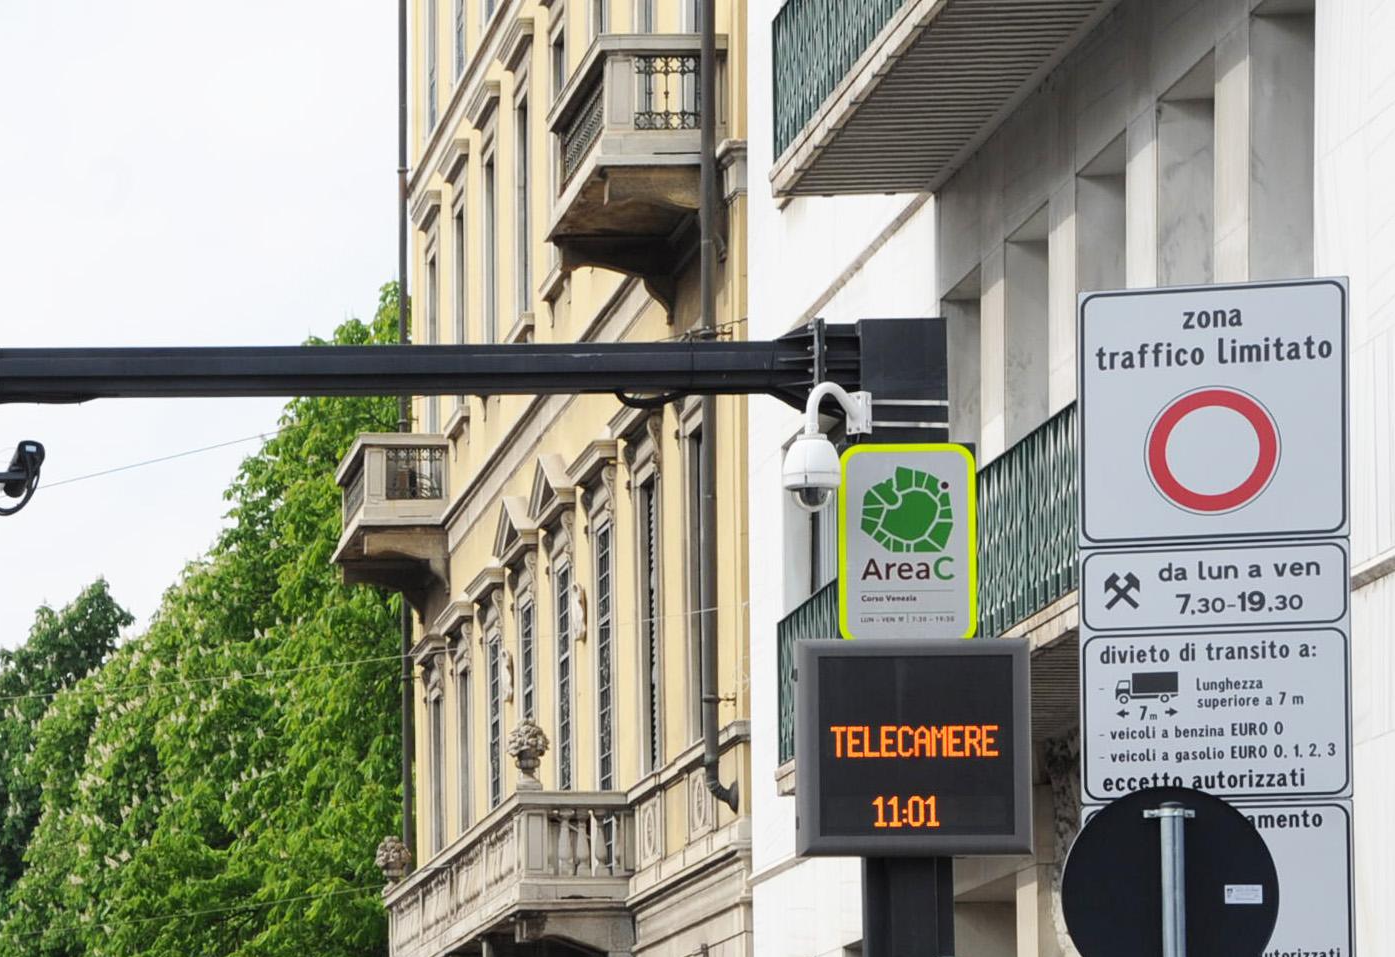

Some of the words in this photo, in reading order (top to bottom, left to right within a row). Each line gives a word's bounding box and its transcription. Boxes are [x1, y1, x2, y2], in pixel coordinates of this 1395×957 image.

[1182, 308, 1243, 330] zona
[1095, 342, 1204, 371] traffico
[1218, 335, 1332, 364] limitato
[1158, 562, 1188, 582] da
[1198, 560, 1239, 581] lun
[1248, 564, 1262, 578] a
[1273, 561, 1321, 577] ven
[885, 594, 917, 602] Venezia
[1099, 646, 1171, 665] divieto
[1179, 643, 1196, 662] di
[1206, 640, 1290, 662] transito
[1299, 643, 1317, 659] a:
[1196, 677, 1264, 693] lunghezza
[1197, 695, 1260, 710] superiore
[1265, 696, 1273, 706] a
[1278, 692, 1287, 705] 7
[1292, 695, 1304, 705] m
[830, 724, 999, 759] TELECAMERE
[1110, 726, 1155, 740] veicoli
[1161, 728, 1169, 739] a
[1174, 725, 1225, 739] benzina
[1231, 722, 1268, 737] EURO
[1110, 748, 1155, 763] veicoli
[1162, 751, 1169, 762] a
[1175, 747, 1225, 763] gasolio
[1230, 745, 1268, 760] EURO
[1327, 742, 1336, 757] 3
[1103, 772, 1184, 792] eccetto
[1192, 768, 1306, 790] autorizzati
[872, 795, 940, 828] 11:01
